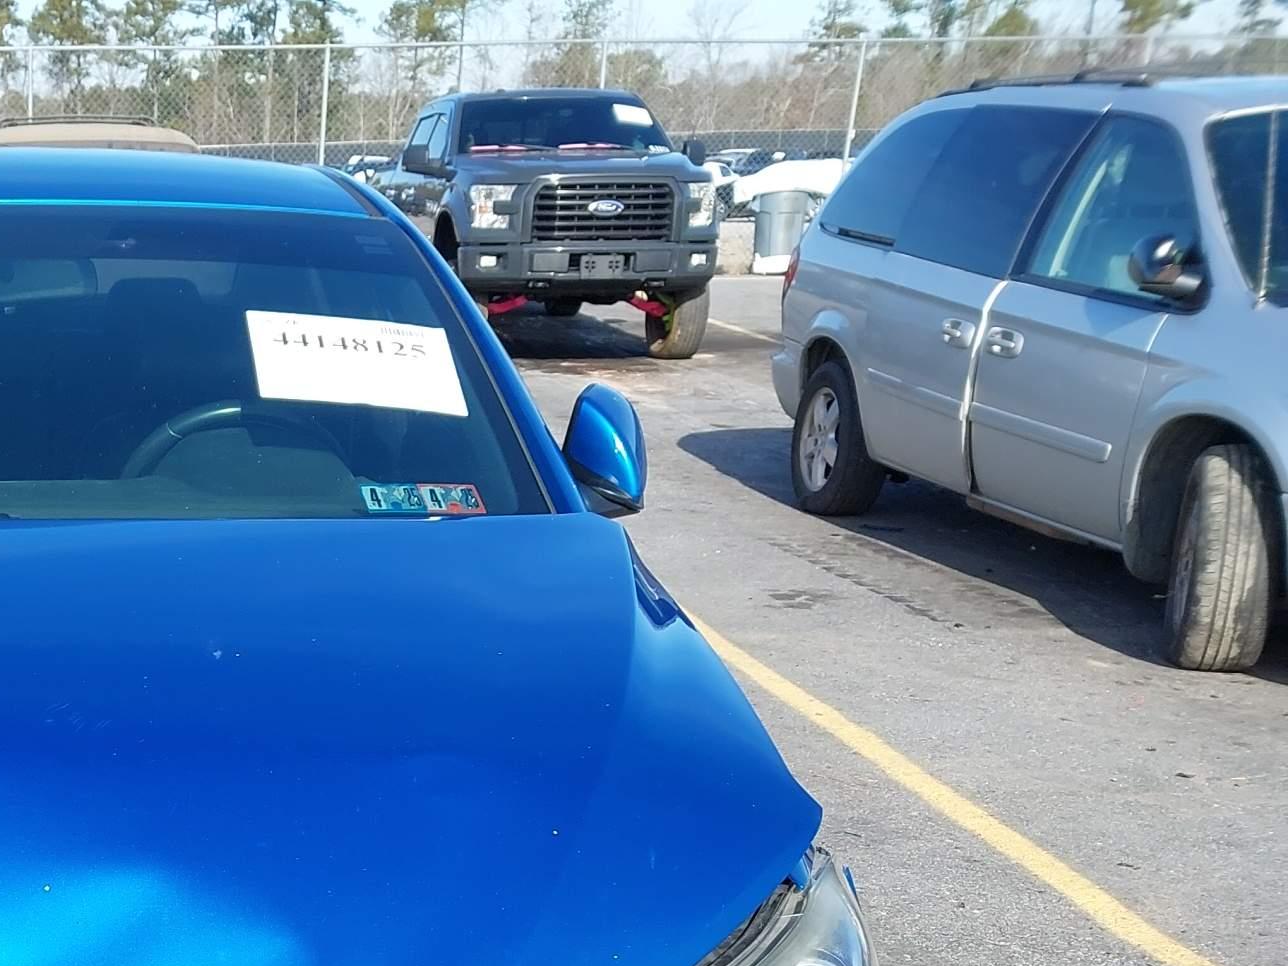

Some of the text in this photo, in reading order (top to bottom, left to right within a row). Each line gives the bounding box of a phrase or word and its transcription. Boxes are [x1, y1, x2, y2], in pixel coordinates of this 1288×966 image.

[273, 332, 426, 358] 44148125
[370, 488, 383, 508] 4
[429, 489, 443, 508] 4
